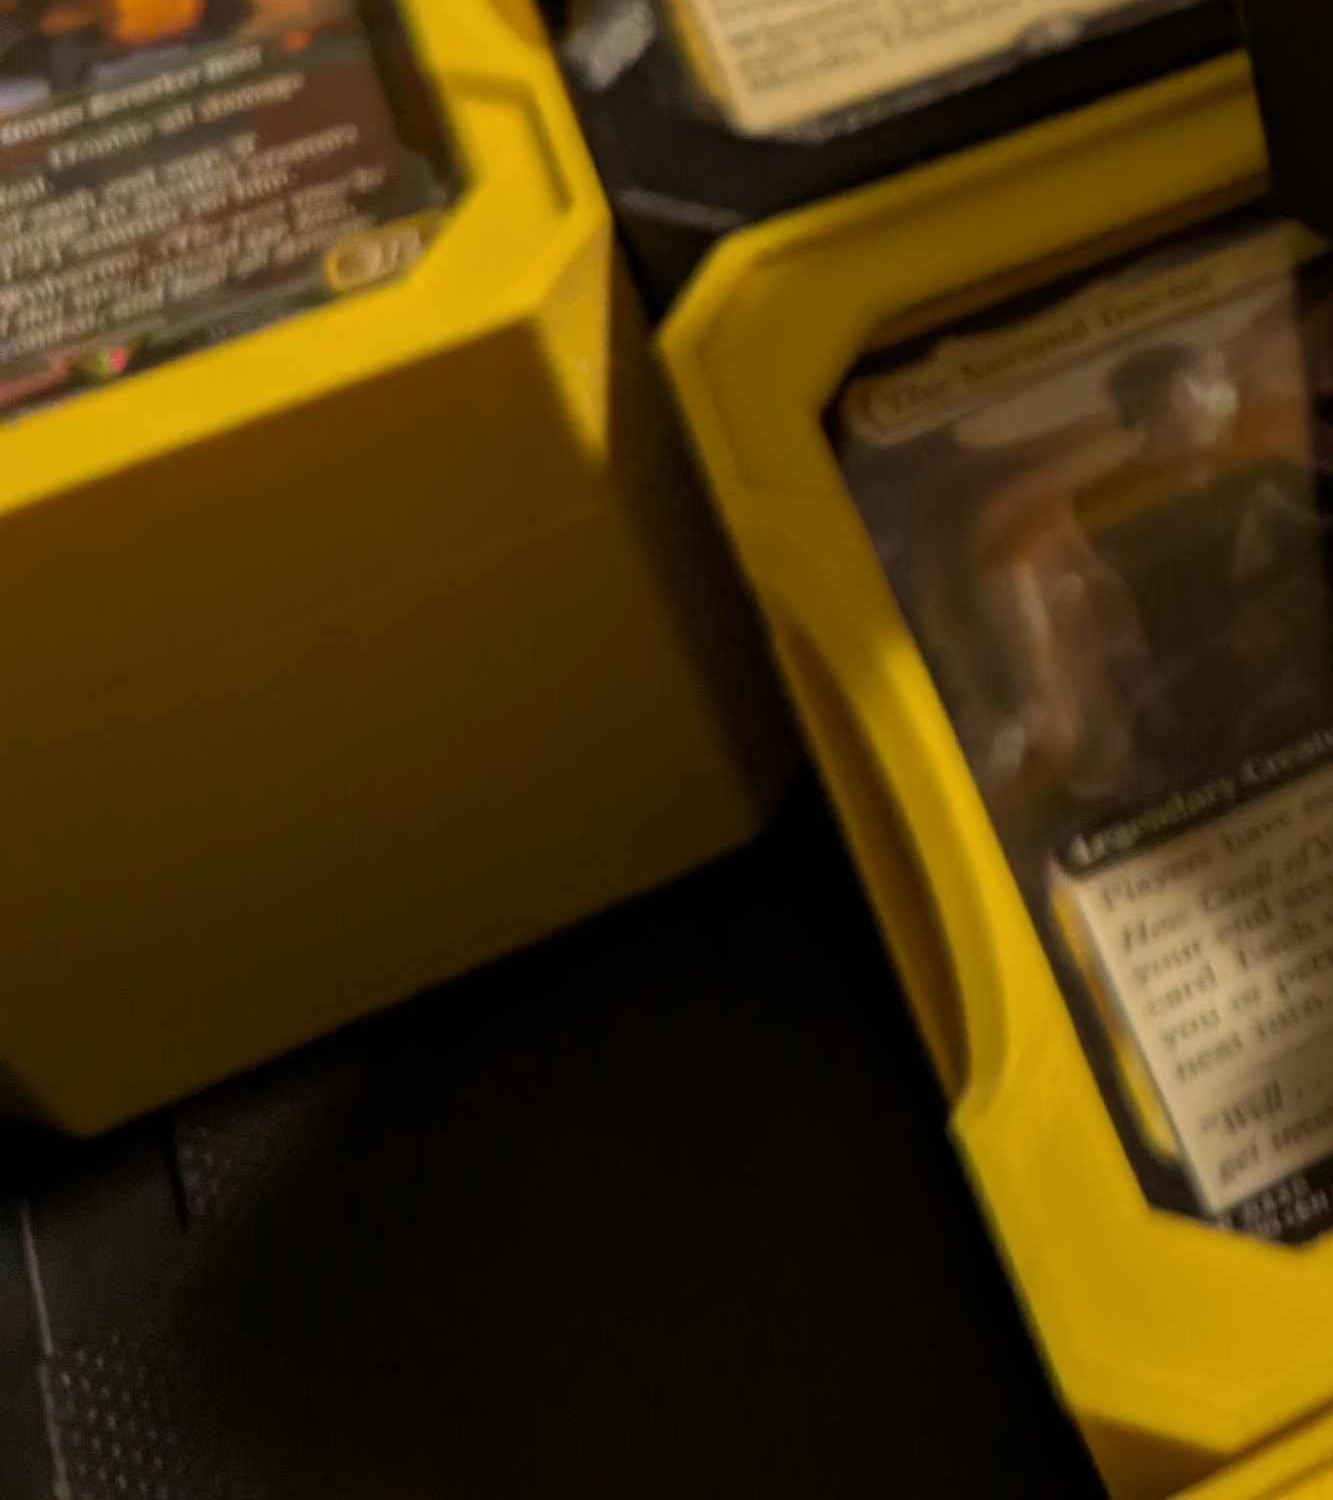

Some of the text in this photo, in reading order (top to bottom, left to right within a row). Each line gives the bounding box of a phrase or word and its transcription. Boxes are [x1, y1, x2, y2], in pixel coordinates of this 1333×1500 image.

[1094, 265, 1218, 332] Doctor
[1066, 768, 1238, 869] Legendary
[1099, 840, 1216, 914] Players
[1217, 800, 1293, 854] have
[1130, 934, 1209, 989] your
[1157, 1001, 1224, 1052] you
[1229, 982, 1266, 1013] or
[1168, 1027, 1249, 1084] next
